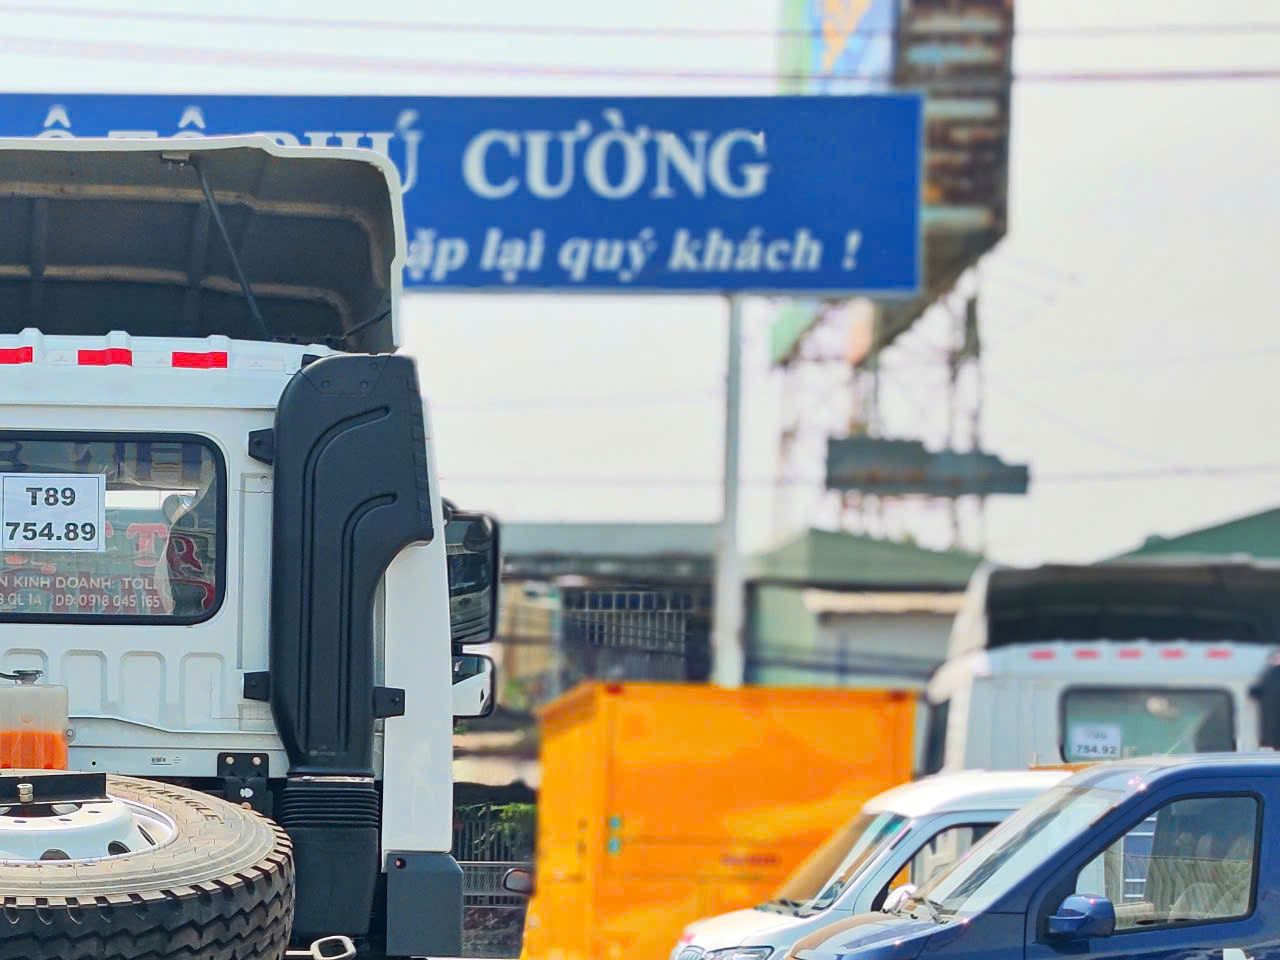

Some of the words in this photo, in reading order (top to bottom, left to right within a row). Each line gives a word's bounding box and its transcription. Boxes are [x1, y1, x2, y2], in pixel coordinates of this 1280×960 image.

[462, 109, 771, 199] CƯỜNG
[406, 228, 469, 281] ặp
[480, 228, 546, 281] lại
[558, 228, 656, 281] quý
[667, 228, 822, 271] khách
[26, 487, 76, 506] T89
[5, 521, 96, 541] 754.89
[14, 576, 50, 588] KINH
[7, 593, 24, 606] QL
[113, 594, 136, 607] 045
[141, 595, 160, 608] 165
